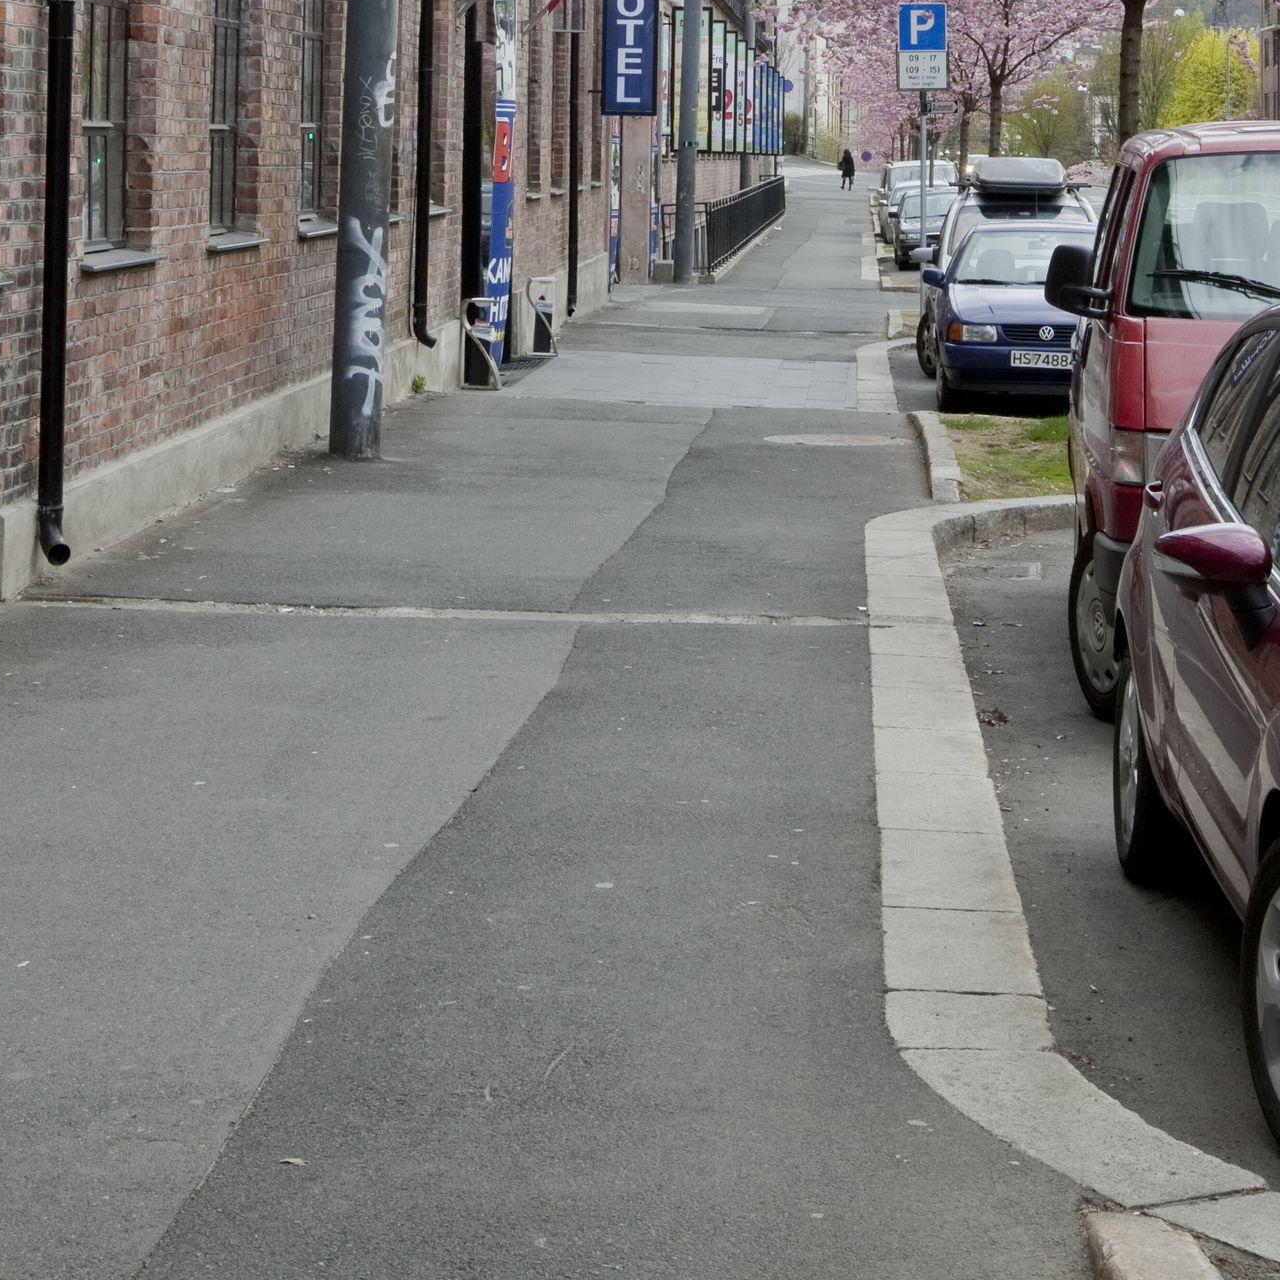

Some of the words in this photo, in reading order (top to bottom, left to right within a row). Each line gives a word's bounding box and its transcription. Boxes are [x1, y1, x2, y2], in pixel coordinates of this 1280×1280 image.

[910, 9, 935, 45] P
[908, 54, 919, 62] 09
[929, 54, 937, 62] 17
[905, 66, 920, 74] (09
[929, 66, 941, 74] 15)
